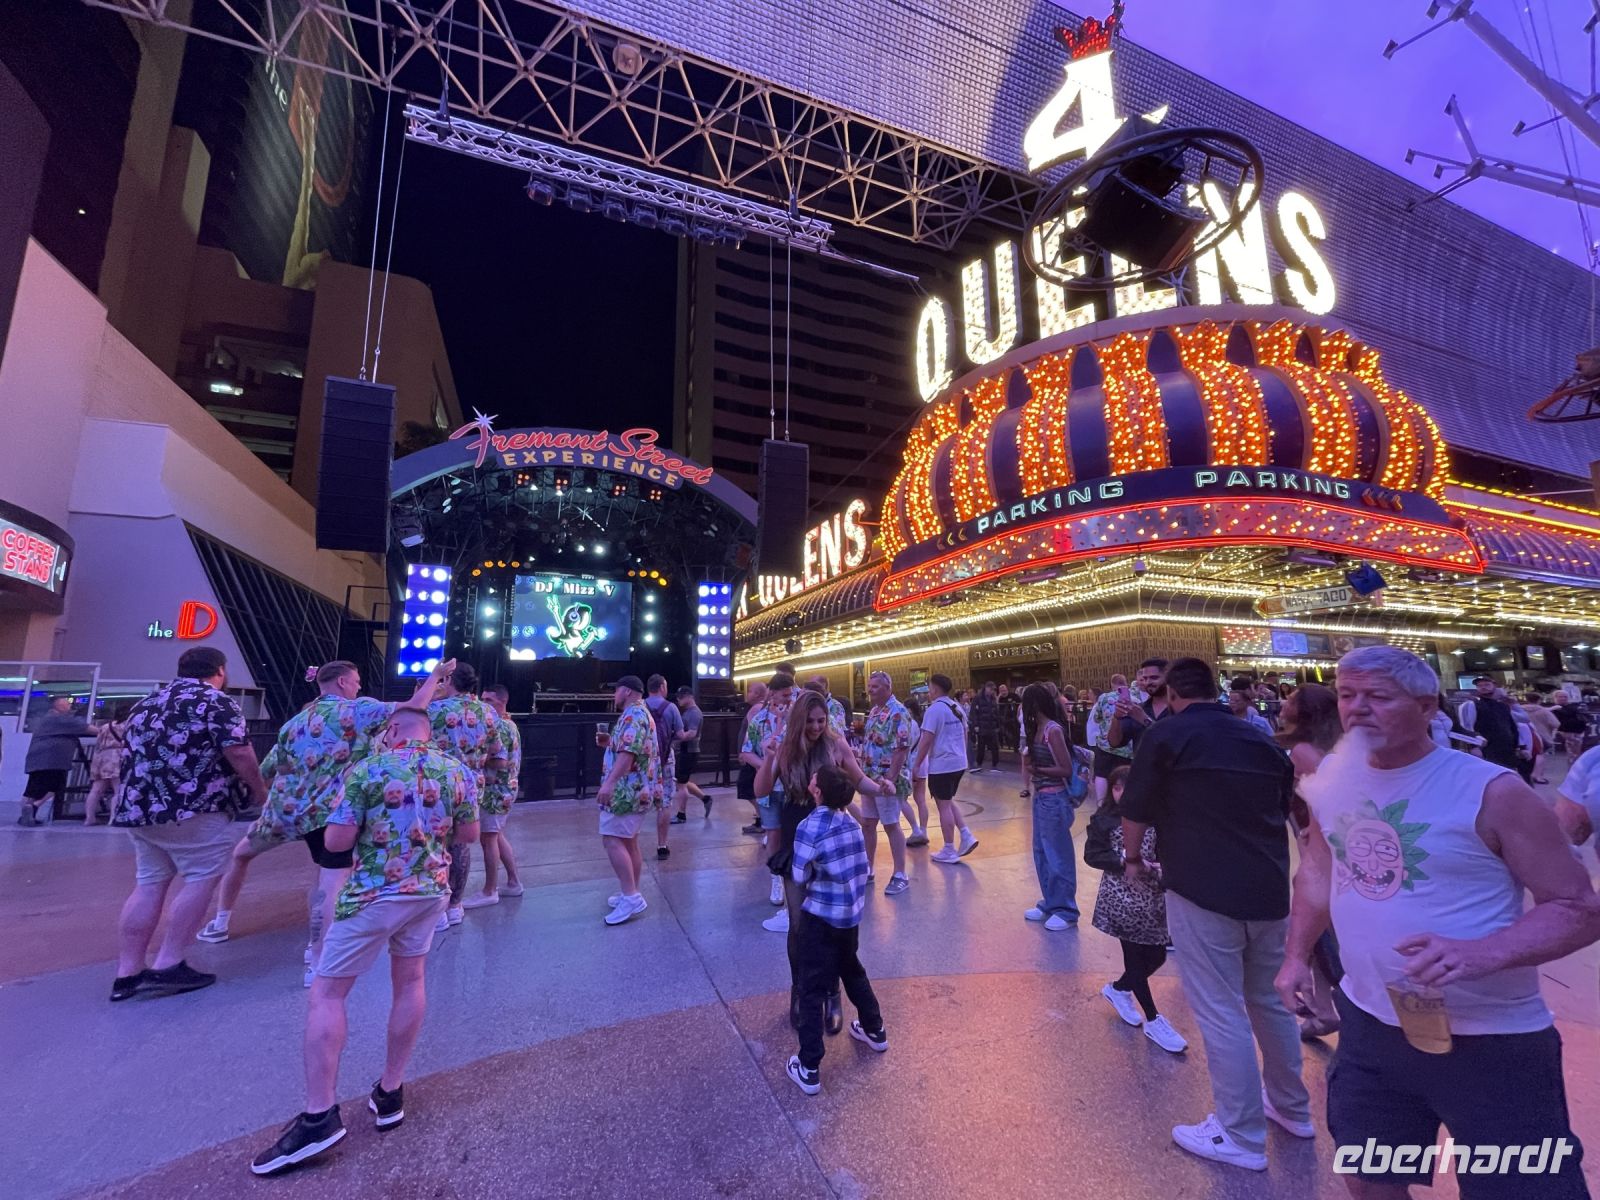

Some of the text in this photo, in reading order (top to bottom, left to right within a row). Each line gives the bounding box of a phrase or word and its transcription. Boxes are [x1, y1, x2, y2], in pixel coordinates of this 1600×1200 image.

[1022, 50, 1169, 172] 4
[449, 419, 713, 484] Fremont Street
[503, 450, 678, 487] EXPERIENCE
[1195, 471, 1351, 500] PARKING
[977, 482, 1124, 534] PARKING
[2, 528, 56, 567] COFFEE
[3, 550, 50, 583] STAND
[535, 582, 614, 596] DJ Mizz V
[1316, 589, 1347, 604] TACO
[148, 601, 218, 639] the D
[974, 642, 1054, 661] 4 QUEENS
